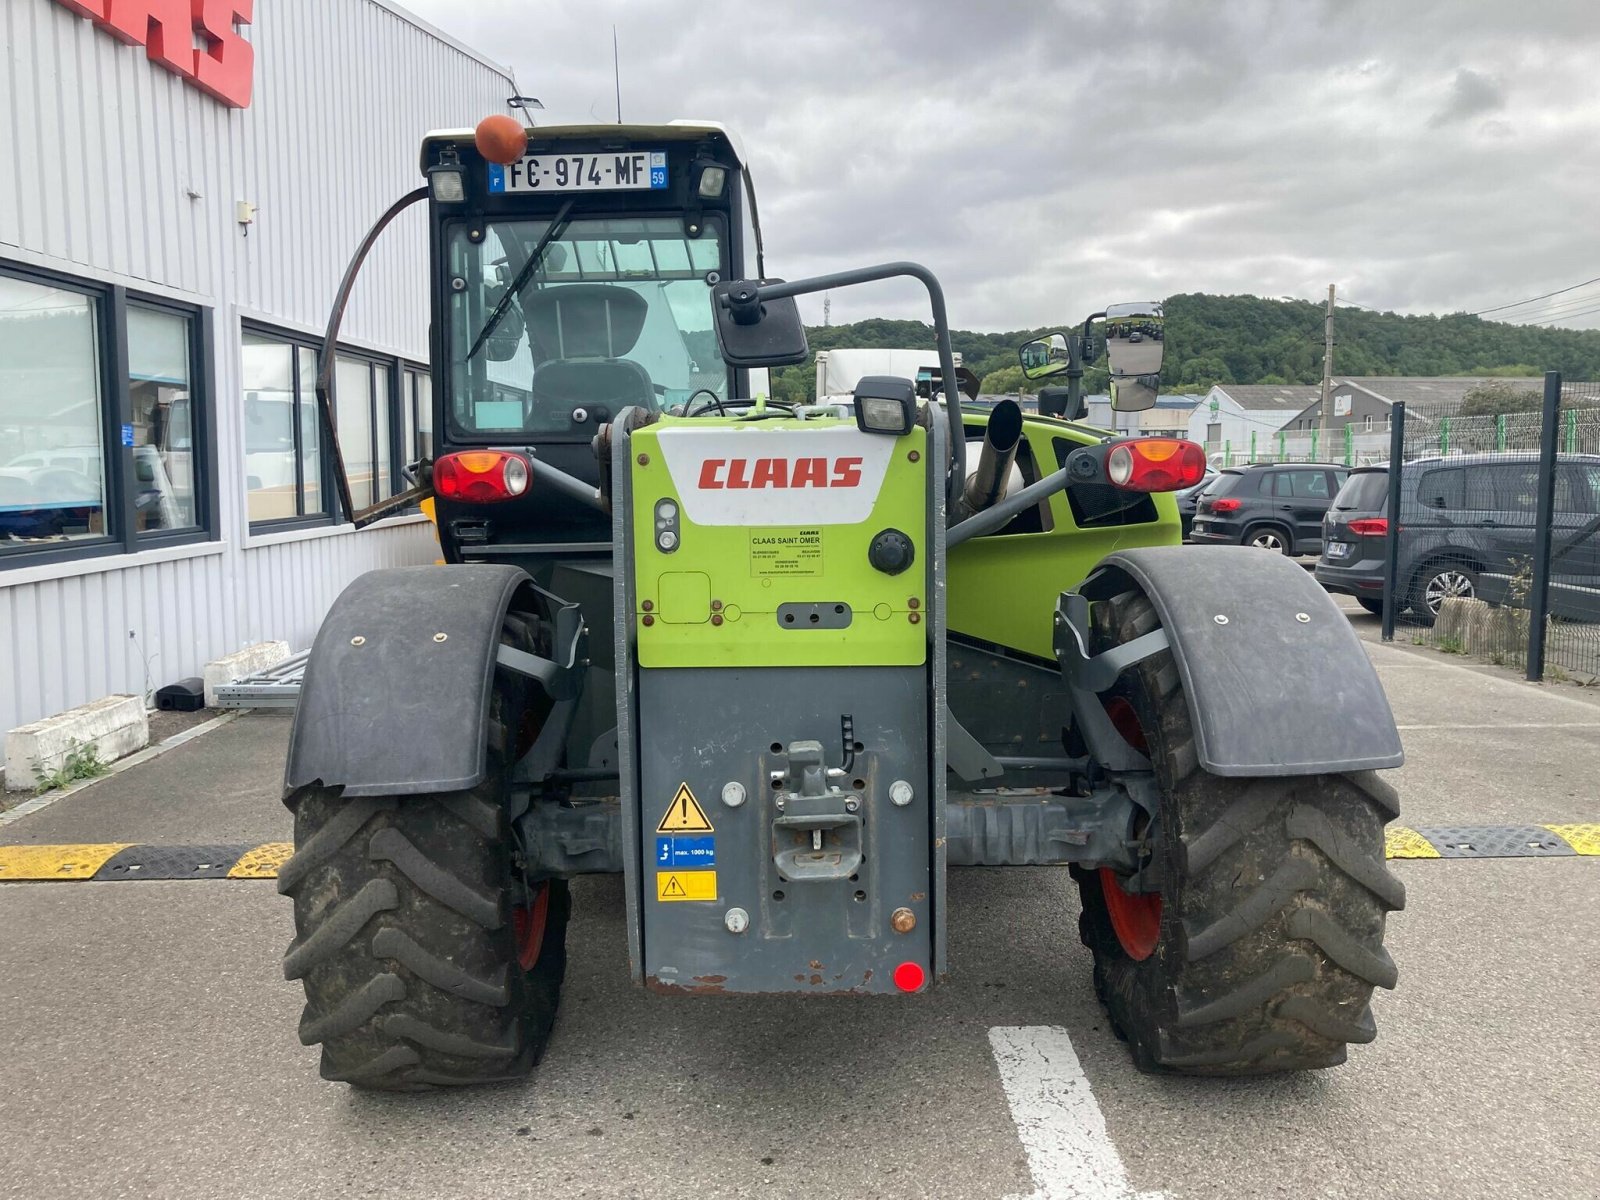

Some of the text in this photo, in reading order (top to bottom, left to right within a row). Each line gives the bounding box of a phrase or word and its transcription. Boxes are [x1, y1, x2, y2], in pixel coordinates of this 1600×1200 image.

[510, 155, 646, 188] FC-974-MF
[651, 171, 666, 185] 59
[492, 178, 500, 187] F
[697, 456, 864, 490] CLAAS
[752, 537, 776, 545] CLAAS
[799, 536, 820, 544] OMER
